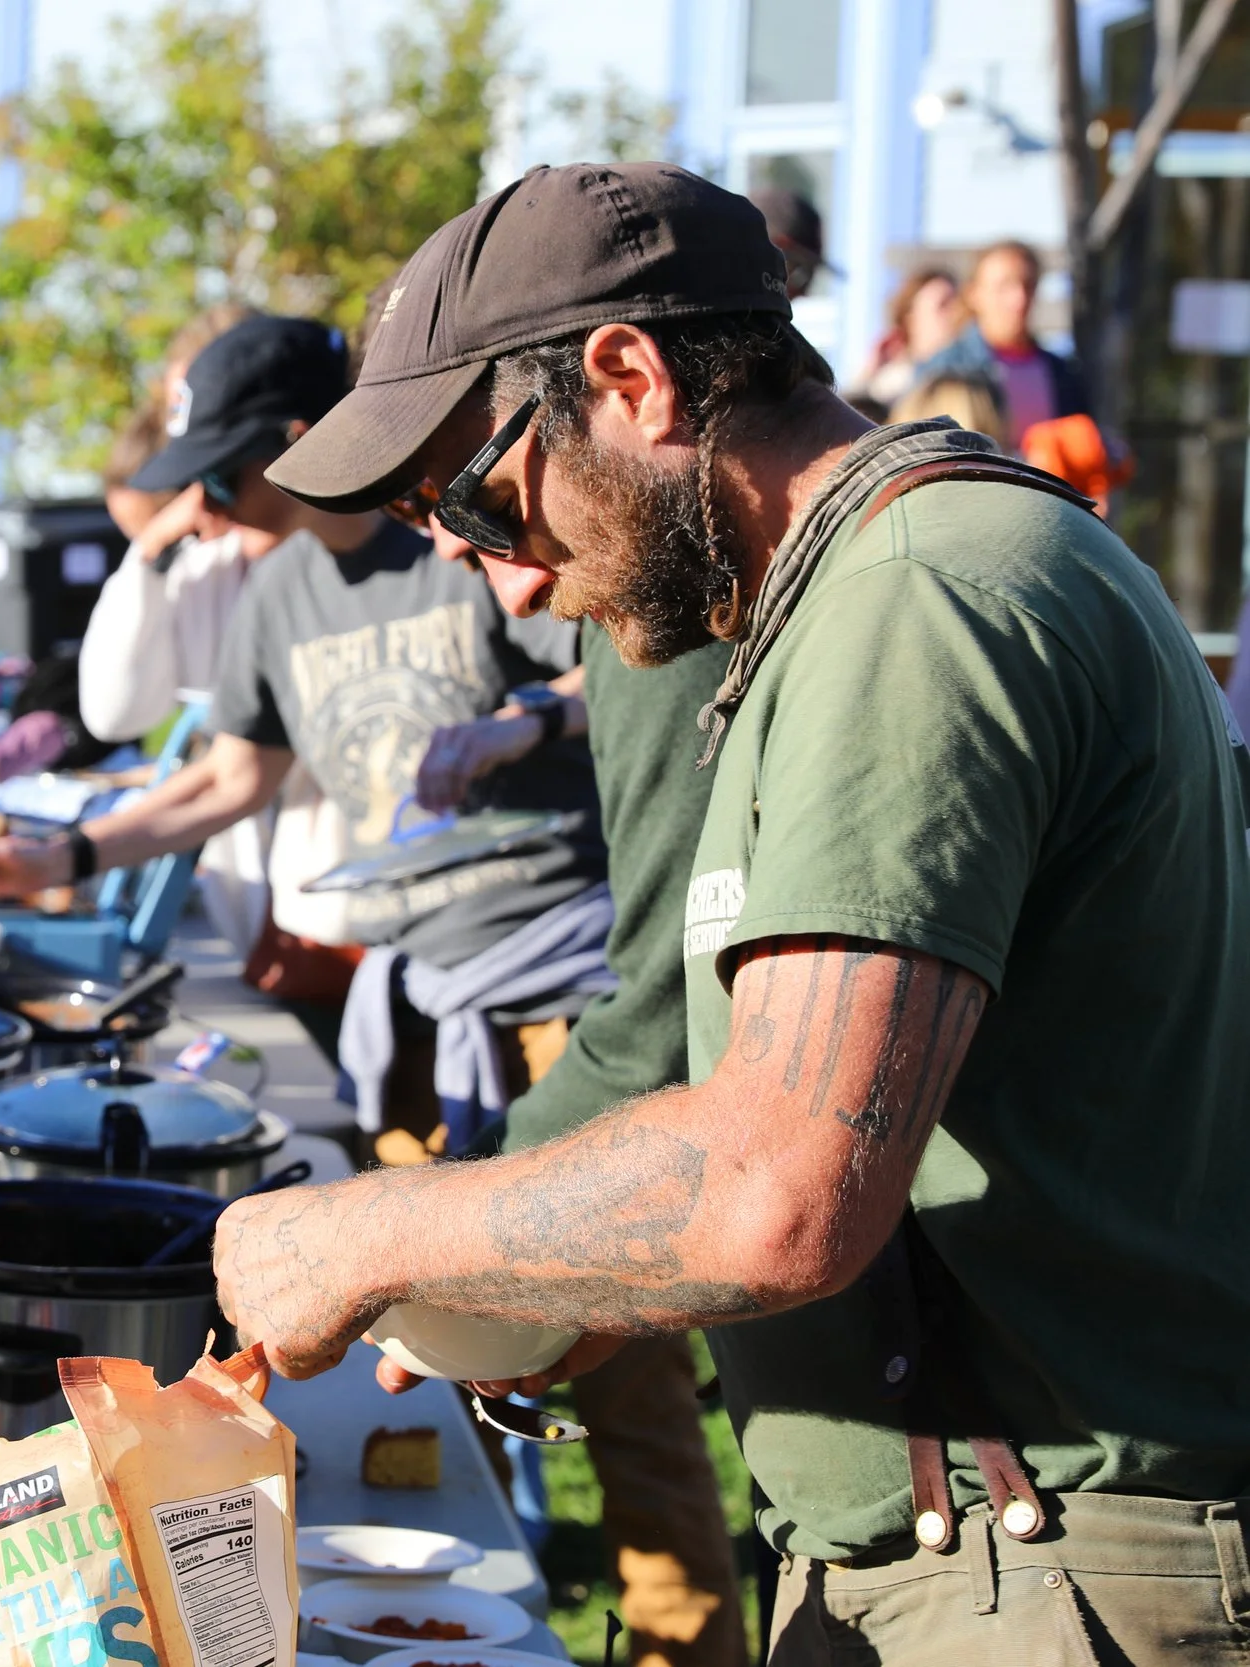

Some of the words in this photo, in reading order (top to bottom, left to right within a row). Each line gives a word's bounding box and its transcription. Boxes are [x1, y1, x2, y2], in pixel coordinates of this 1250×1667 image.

[159, 1507, 209, 1527] Nutrition
[219, 1497, 253, 1513] Facts
[199, 1515, 225, 1525] container
[175, 1552, 204, 1570] Calories
[226, 1535, 253, 1551] 140
